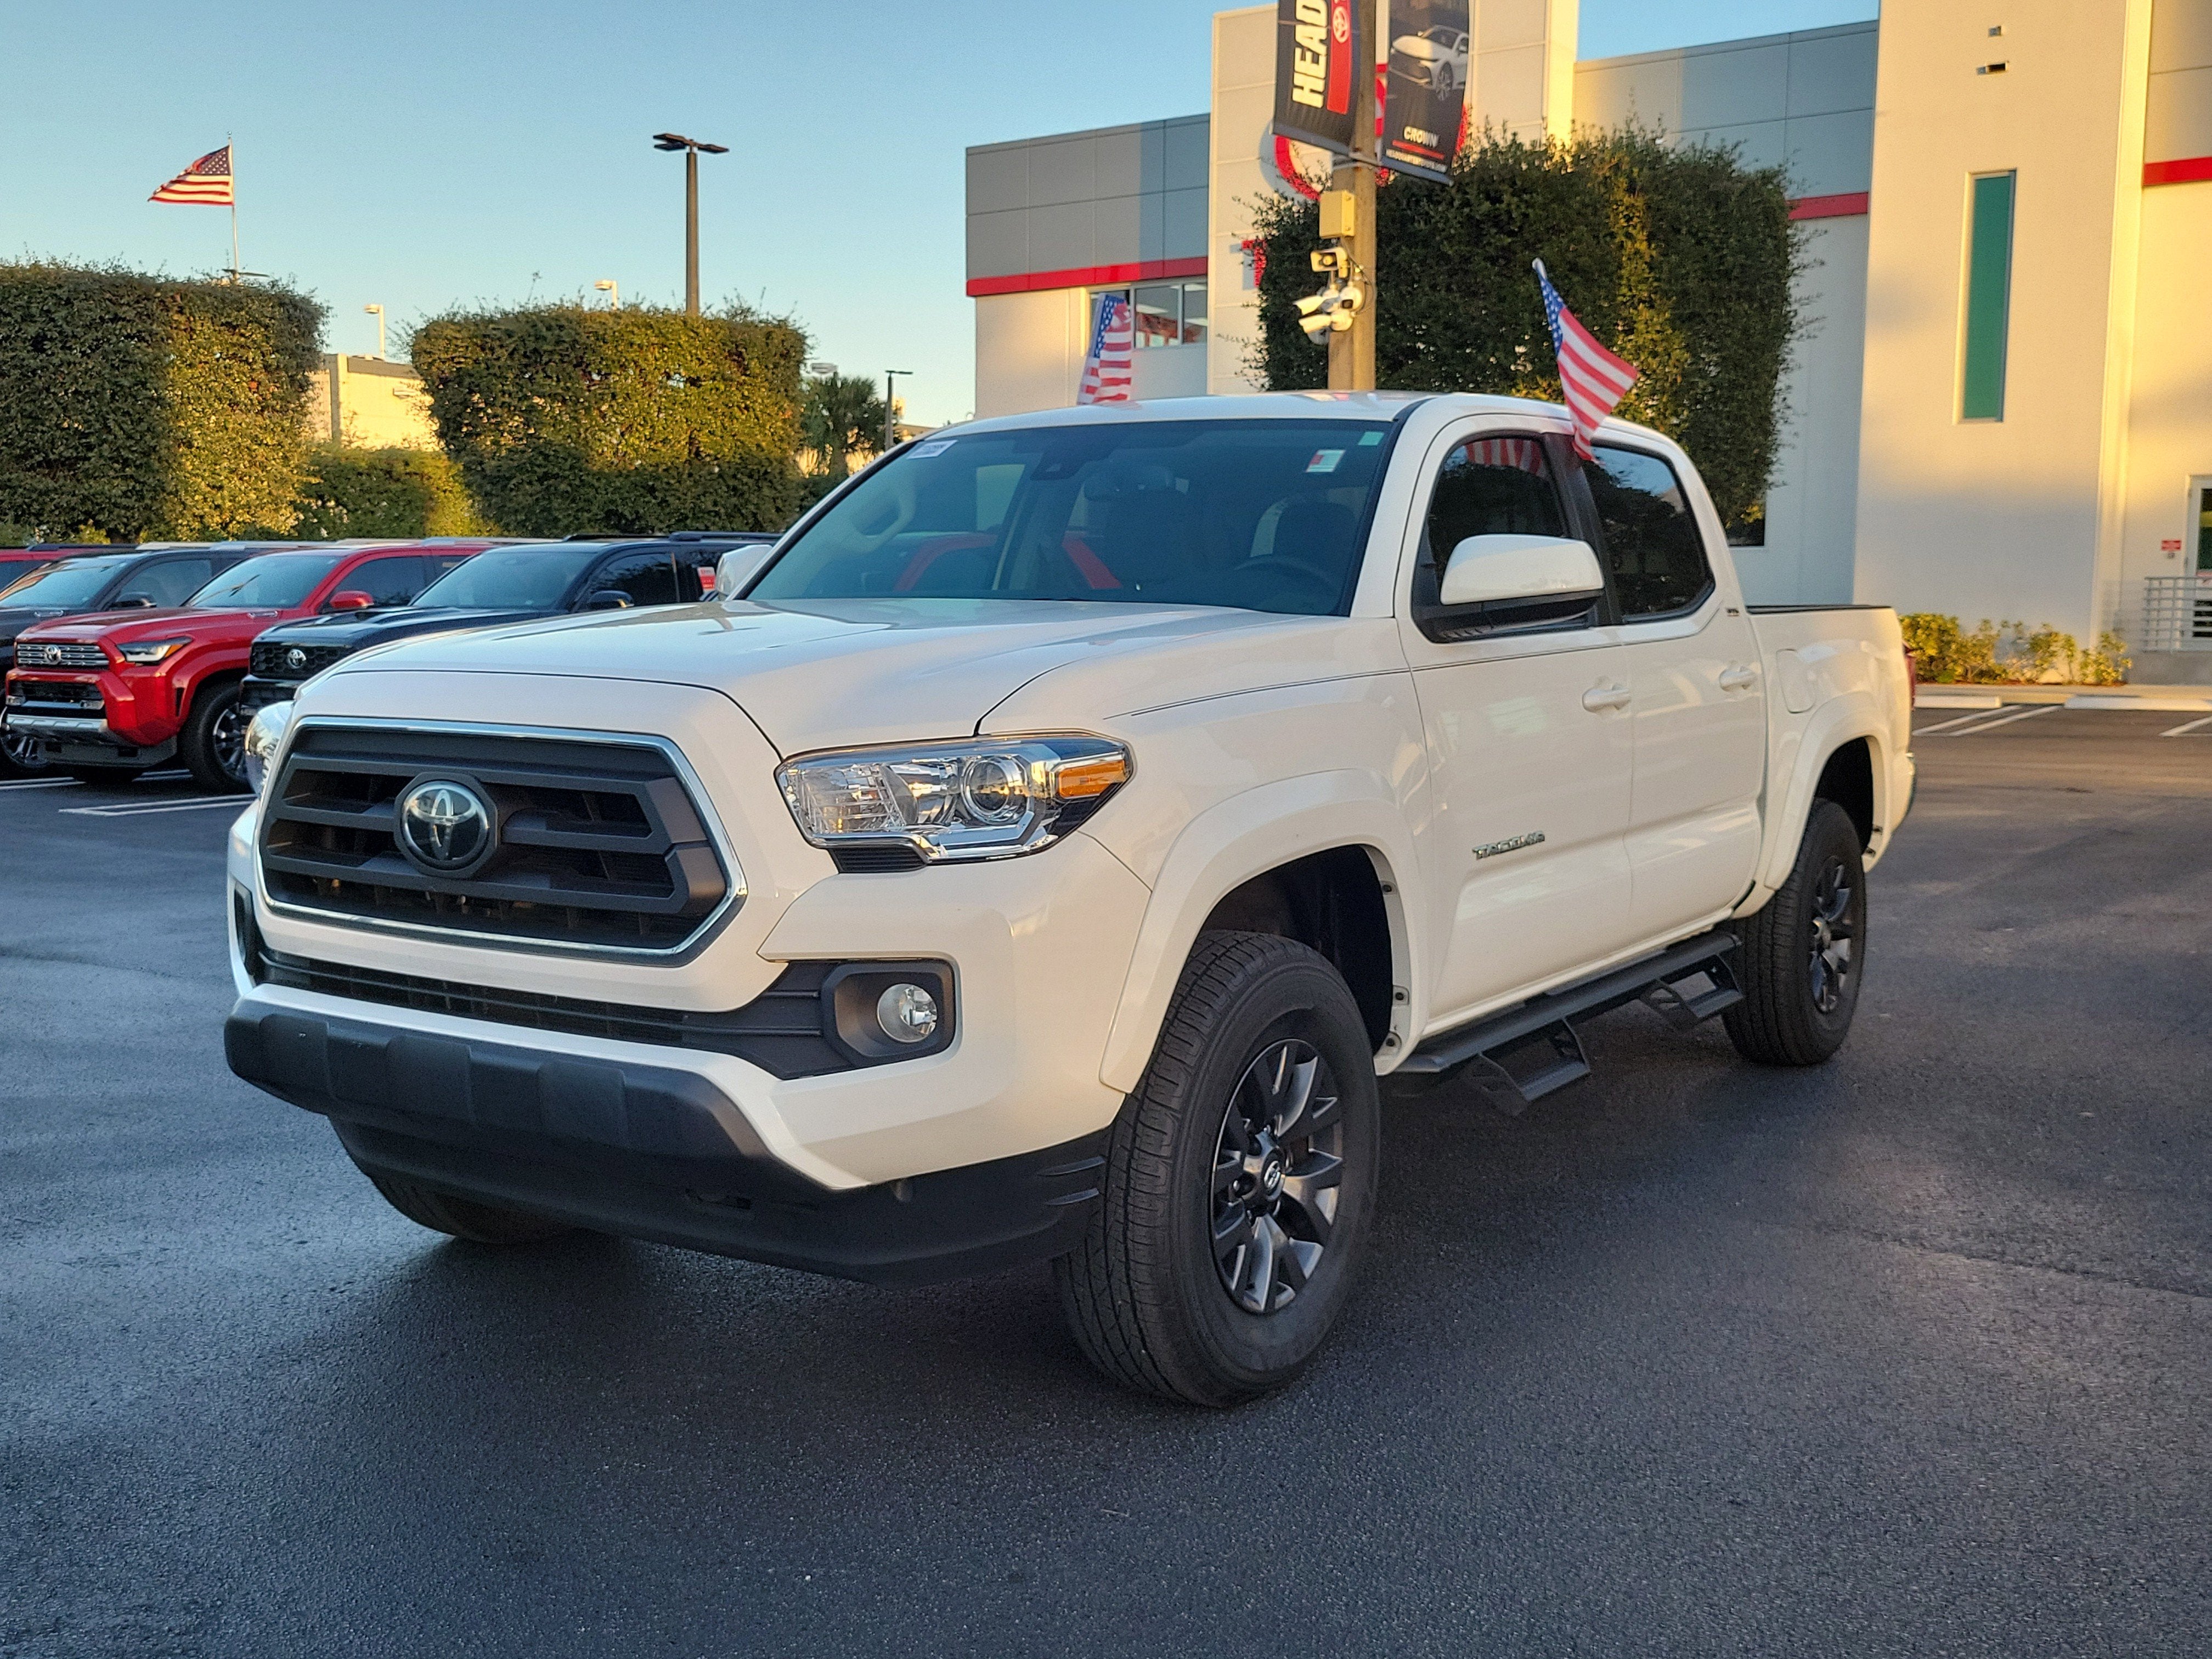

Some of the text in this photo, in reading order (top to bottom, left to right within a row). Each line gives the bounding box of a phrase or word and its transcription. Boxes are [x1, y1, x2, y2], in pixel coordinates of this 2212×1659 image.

[1293, 0, 1328, 108] HEAD
[1404, 126, 1438, 148] CROWN
[1472, 830, 1545, 860] TACOMA
